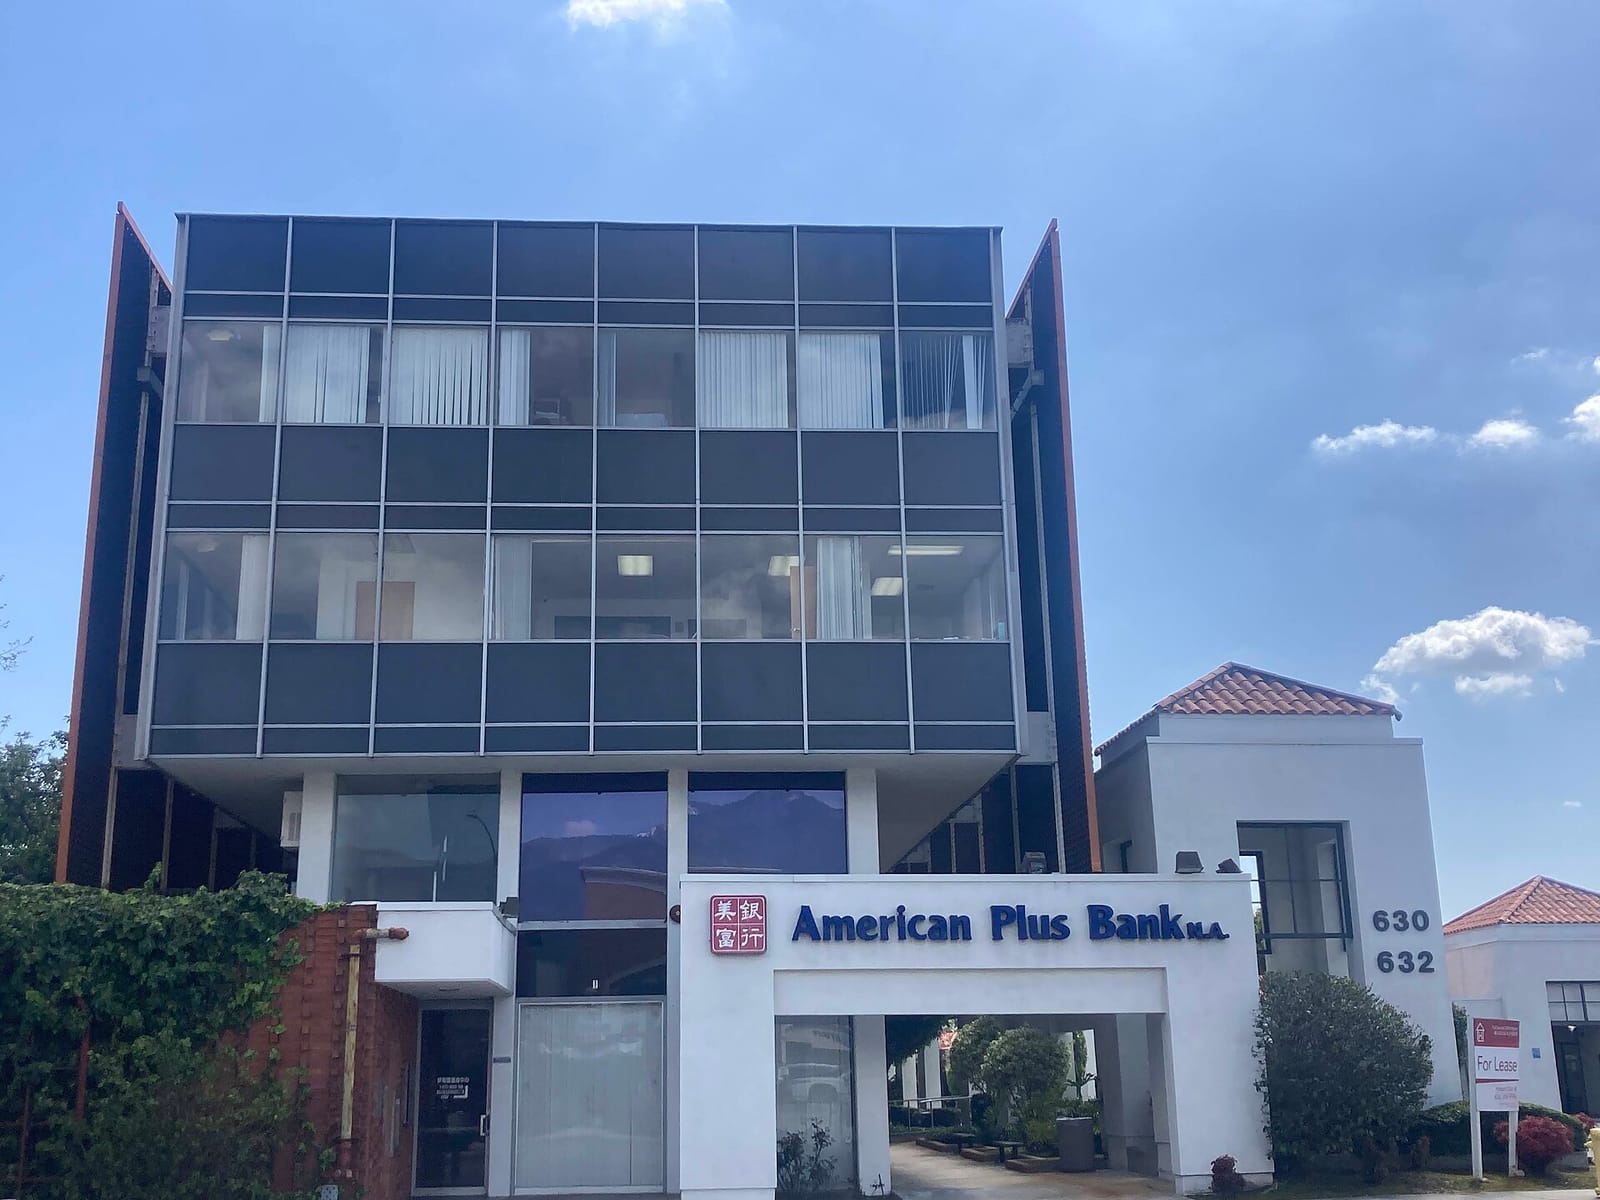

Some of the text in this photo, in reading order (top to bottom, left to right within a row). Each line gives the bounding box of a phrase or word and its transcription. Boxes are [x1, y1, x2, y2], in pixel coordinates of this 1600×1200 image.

[792, 904, 1230, 941] American Plus Bank N.A.
[1372, 909, 1429, 932] 630
[1377, 950, 1435, 974] 632
[1477, 1055, 1518, 1073] For Lease
